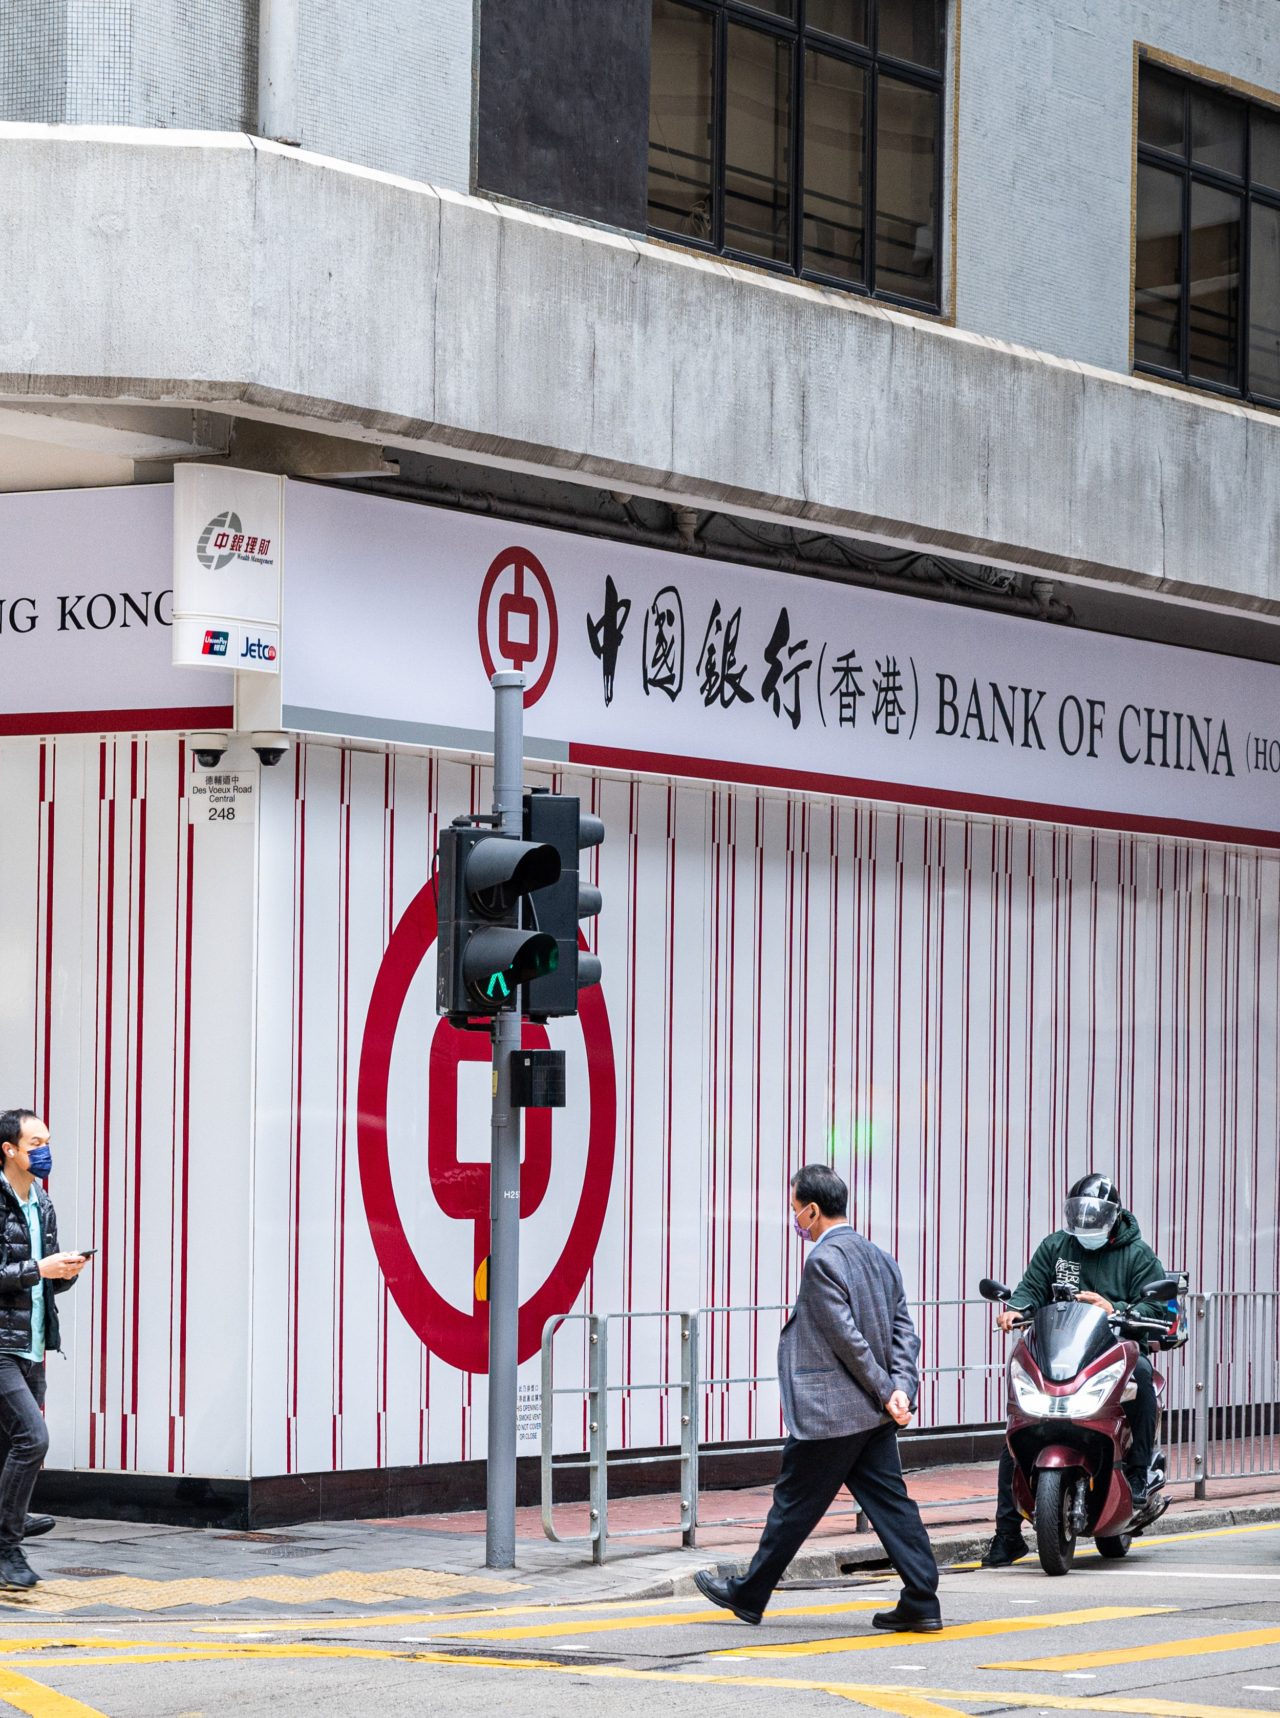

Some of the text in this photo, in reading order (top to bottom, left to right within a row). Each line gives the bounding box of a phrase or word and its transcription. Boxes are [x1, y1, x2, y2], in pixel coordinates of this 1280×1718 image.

[214, 532, 271, 556] 中銀理財
[205, 636, 228, 647] UnionPay
[935, 673, 1047, 750] BANK
[1058, 695, 1106, 759] OF
[1119, 704, 1235, 777] CHINA
[192, 785, 253, 794] Des Voeux Road
[209, 794, 236, 802] Central
[208, 807, 236, 821] 248
